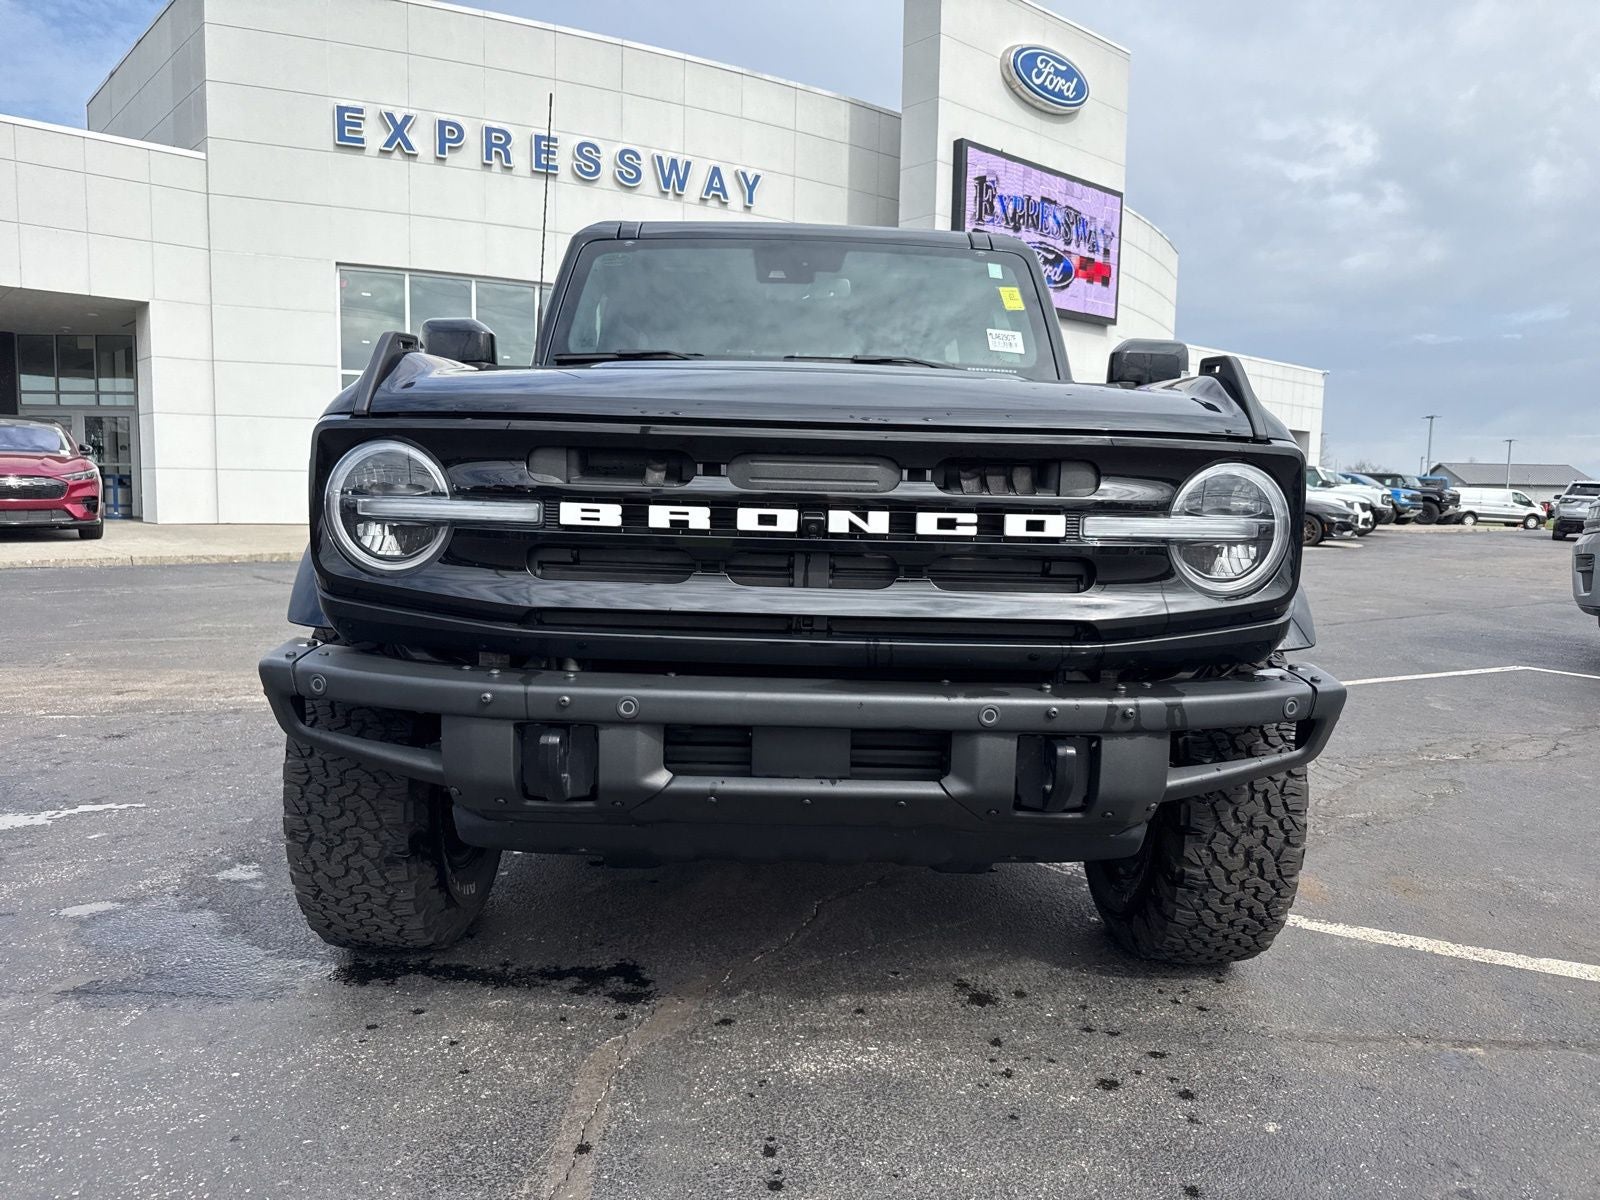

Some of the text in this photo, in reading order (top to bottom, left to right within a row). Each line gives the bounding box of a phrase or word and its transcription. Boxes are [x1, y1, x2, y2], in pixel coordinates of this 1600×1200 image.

[1031, 54, 1077, 99] Ford
[333, 103, 764, 208] EXPRESSWAY
[559, 502, 1067, 538] BRONCO
